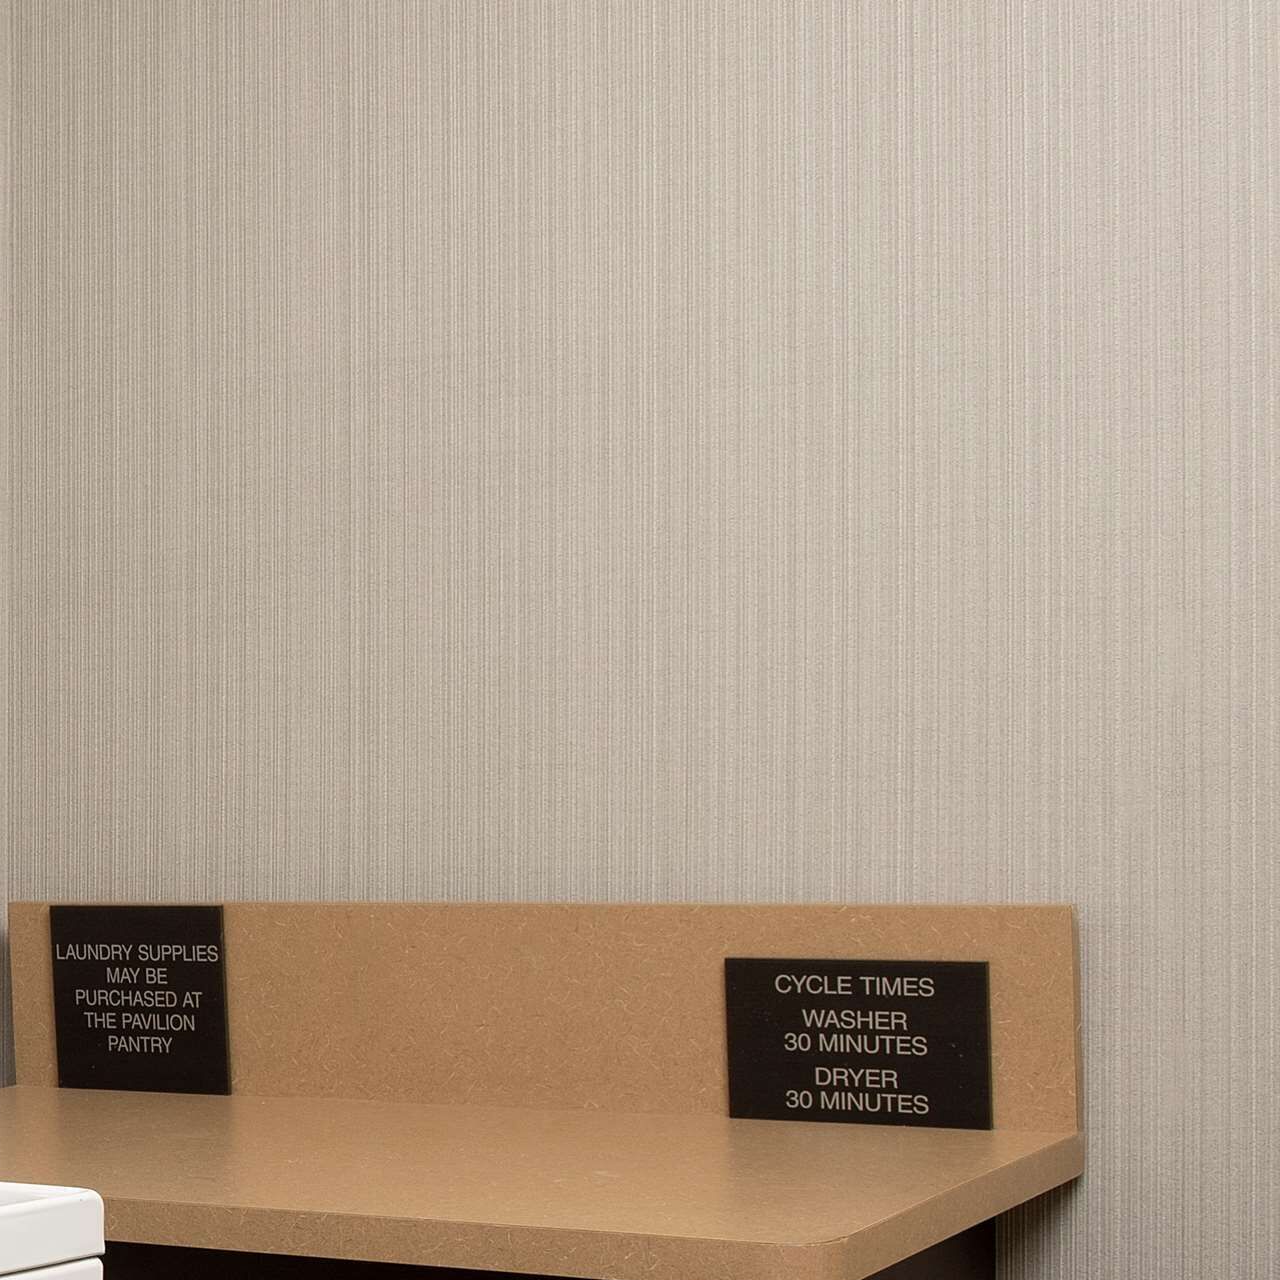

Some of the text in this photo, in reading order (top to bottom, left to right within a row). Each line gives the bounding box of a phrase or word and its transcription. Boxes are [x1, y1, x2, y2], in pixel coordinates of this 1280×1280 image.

[55, 943, 219, 962] LAUNDRY SUPPLIES
[106, 967, 168, 984] MAY BE
[774, 974, 935, 997] CYCLE TIMES
[75, 989, 203, 1008] PURCHASED AT
[83, 1011, 196, 1031] THE PAVILION
[802, 1008, 909, 1031] WASHER
[108, 1035, 173, 1053] PANTRY
[783, 1032, 928, 1056] 30 MINUTES
[815, 1067, 899, 1089] DRYER
[785, 1090, 929, 1114] 30 MINUTES
